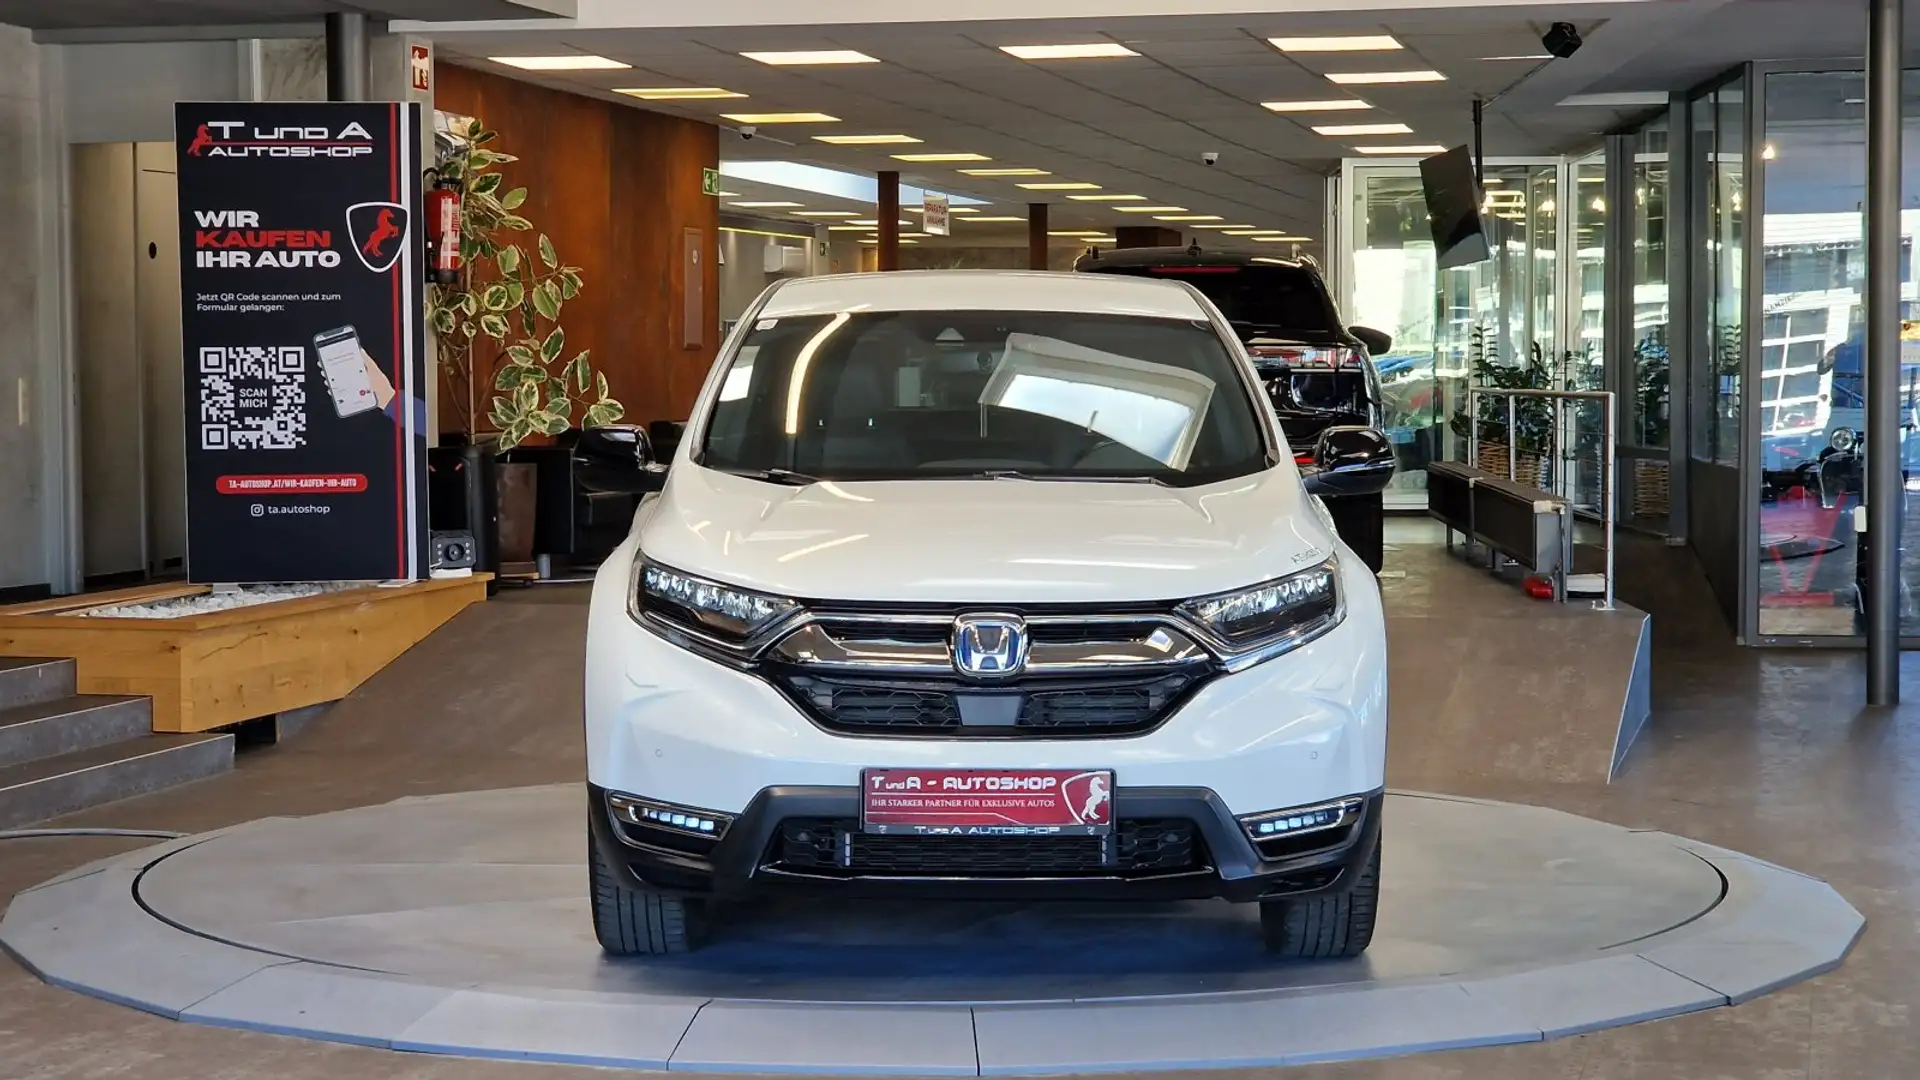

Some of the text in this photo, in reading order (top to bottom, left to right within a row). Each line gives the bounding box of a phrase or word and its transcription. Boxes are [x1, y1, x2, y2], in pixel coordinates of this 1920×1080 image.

[208, 121, 245, 139] T
[337, 121, 373, 139] A
[208, 146, 373, 157] AUTOSHOP
[194, 210, 259, 228] WIR
[196, 230, 331, 248] KAUFEN
[196, 251, 341, 268] IHR AUTO
[196, 292, 341, 302] Jetzt QR Code scannen und zum
[196, 303, 285, 313] Formular gelangen:
[239, 388, 268, 398] SCAN
[239, 398, 268, 408] MICH
[268, 504, 331, 515] ta.autoshop
[943, 776, 1057, 790] AUTOSHOP
[871, 798, 1056, 808] IHR STARKER PARTNER FÜR EXKLUSIVE AUTOS
[968, 826, 1061, 834] AUTOSHOP
